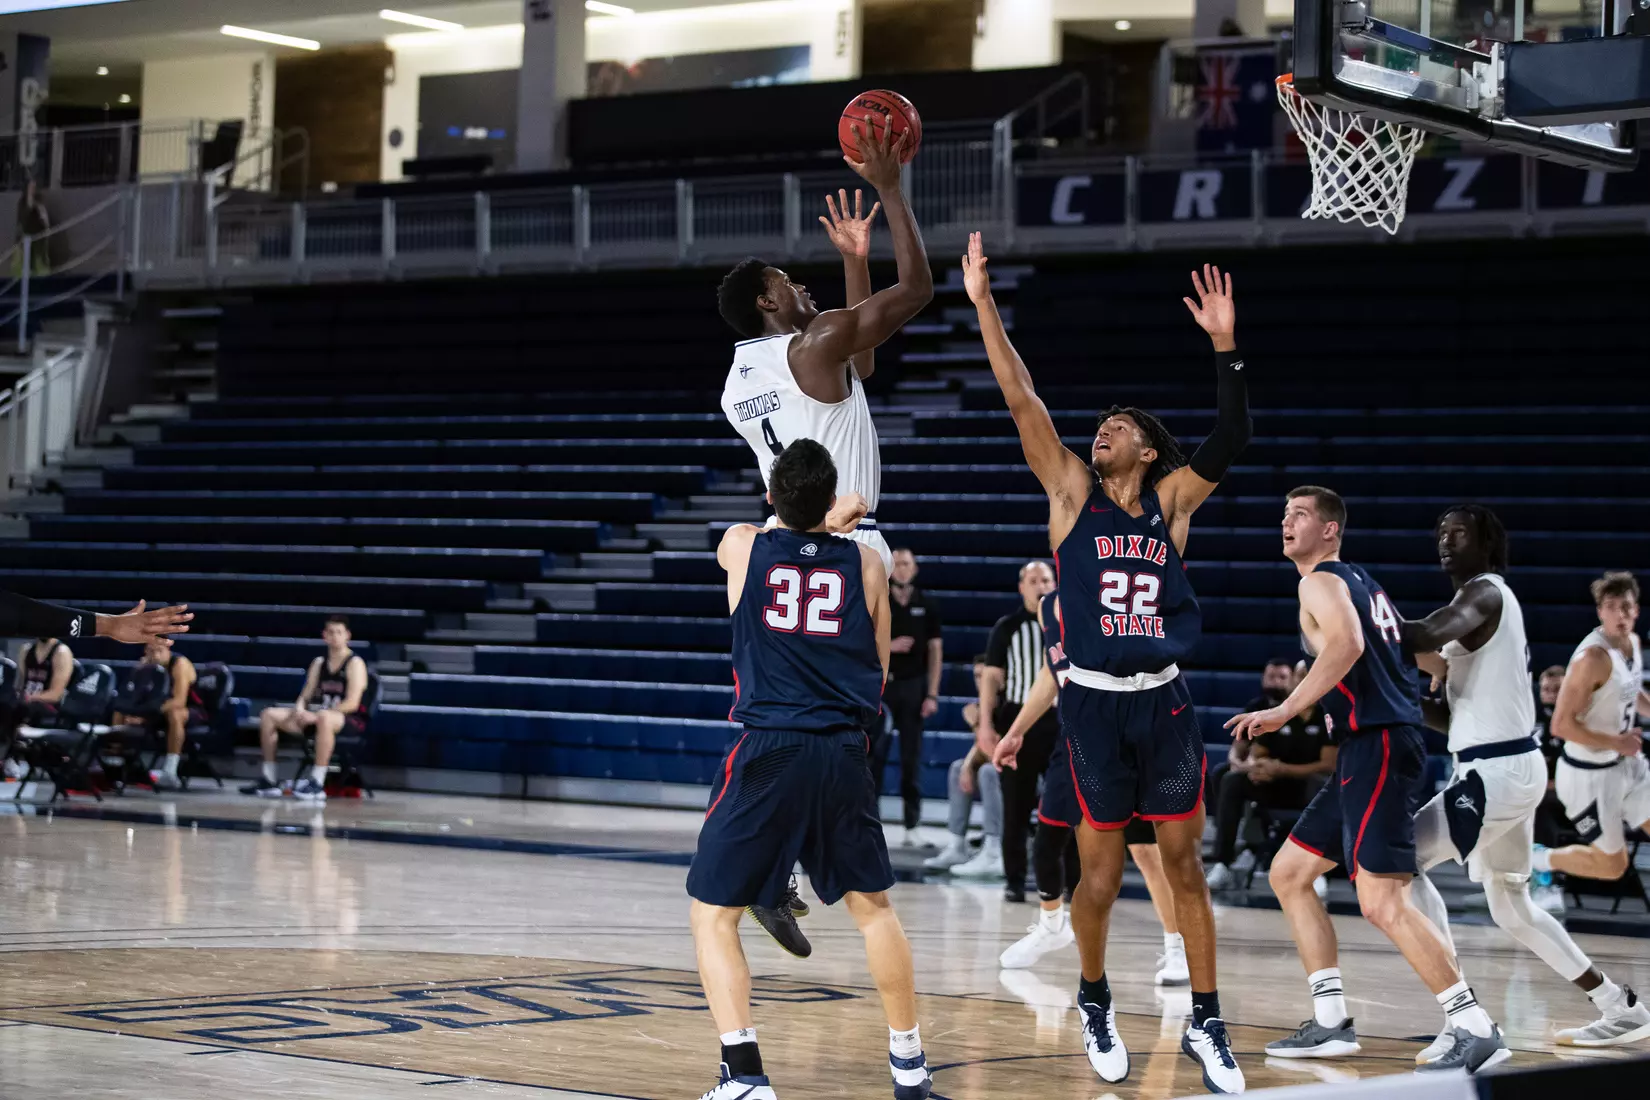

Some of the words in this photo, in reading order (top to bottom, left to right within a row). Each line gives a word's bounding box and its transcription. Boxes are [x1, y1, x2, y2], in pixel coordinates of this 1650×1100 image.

[856, 99, 891, 117] NCAA
[733, 391, 781, 422] THOMAS
[761, 417, 785, 456] 4
[1094, 535, 1167, 566] DIXIE
[762, 564, 845, 637] 32
[1099, 569, 1162, 615] 22
[1100, 614, 1165, 638] STATE
[1618, 701, 1634, 735] 5
